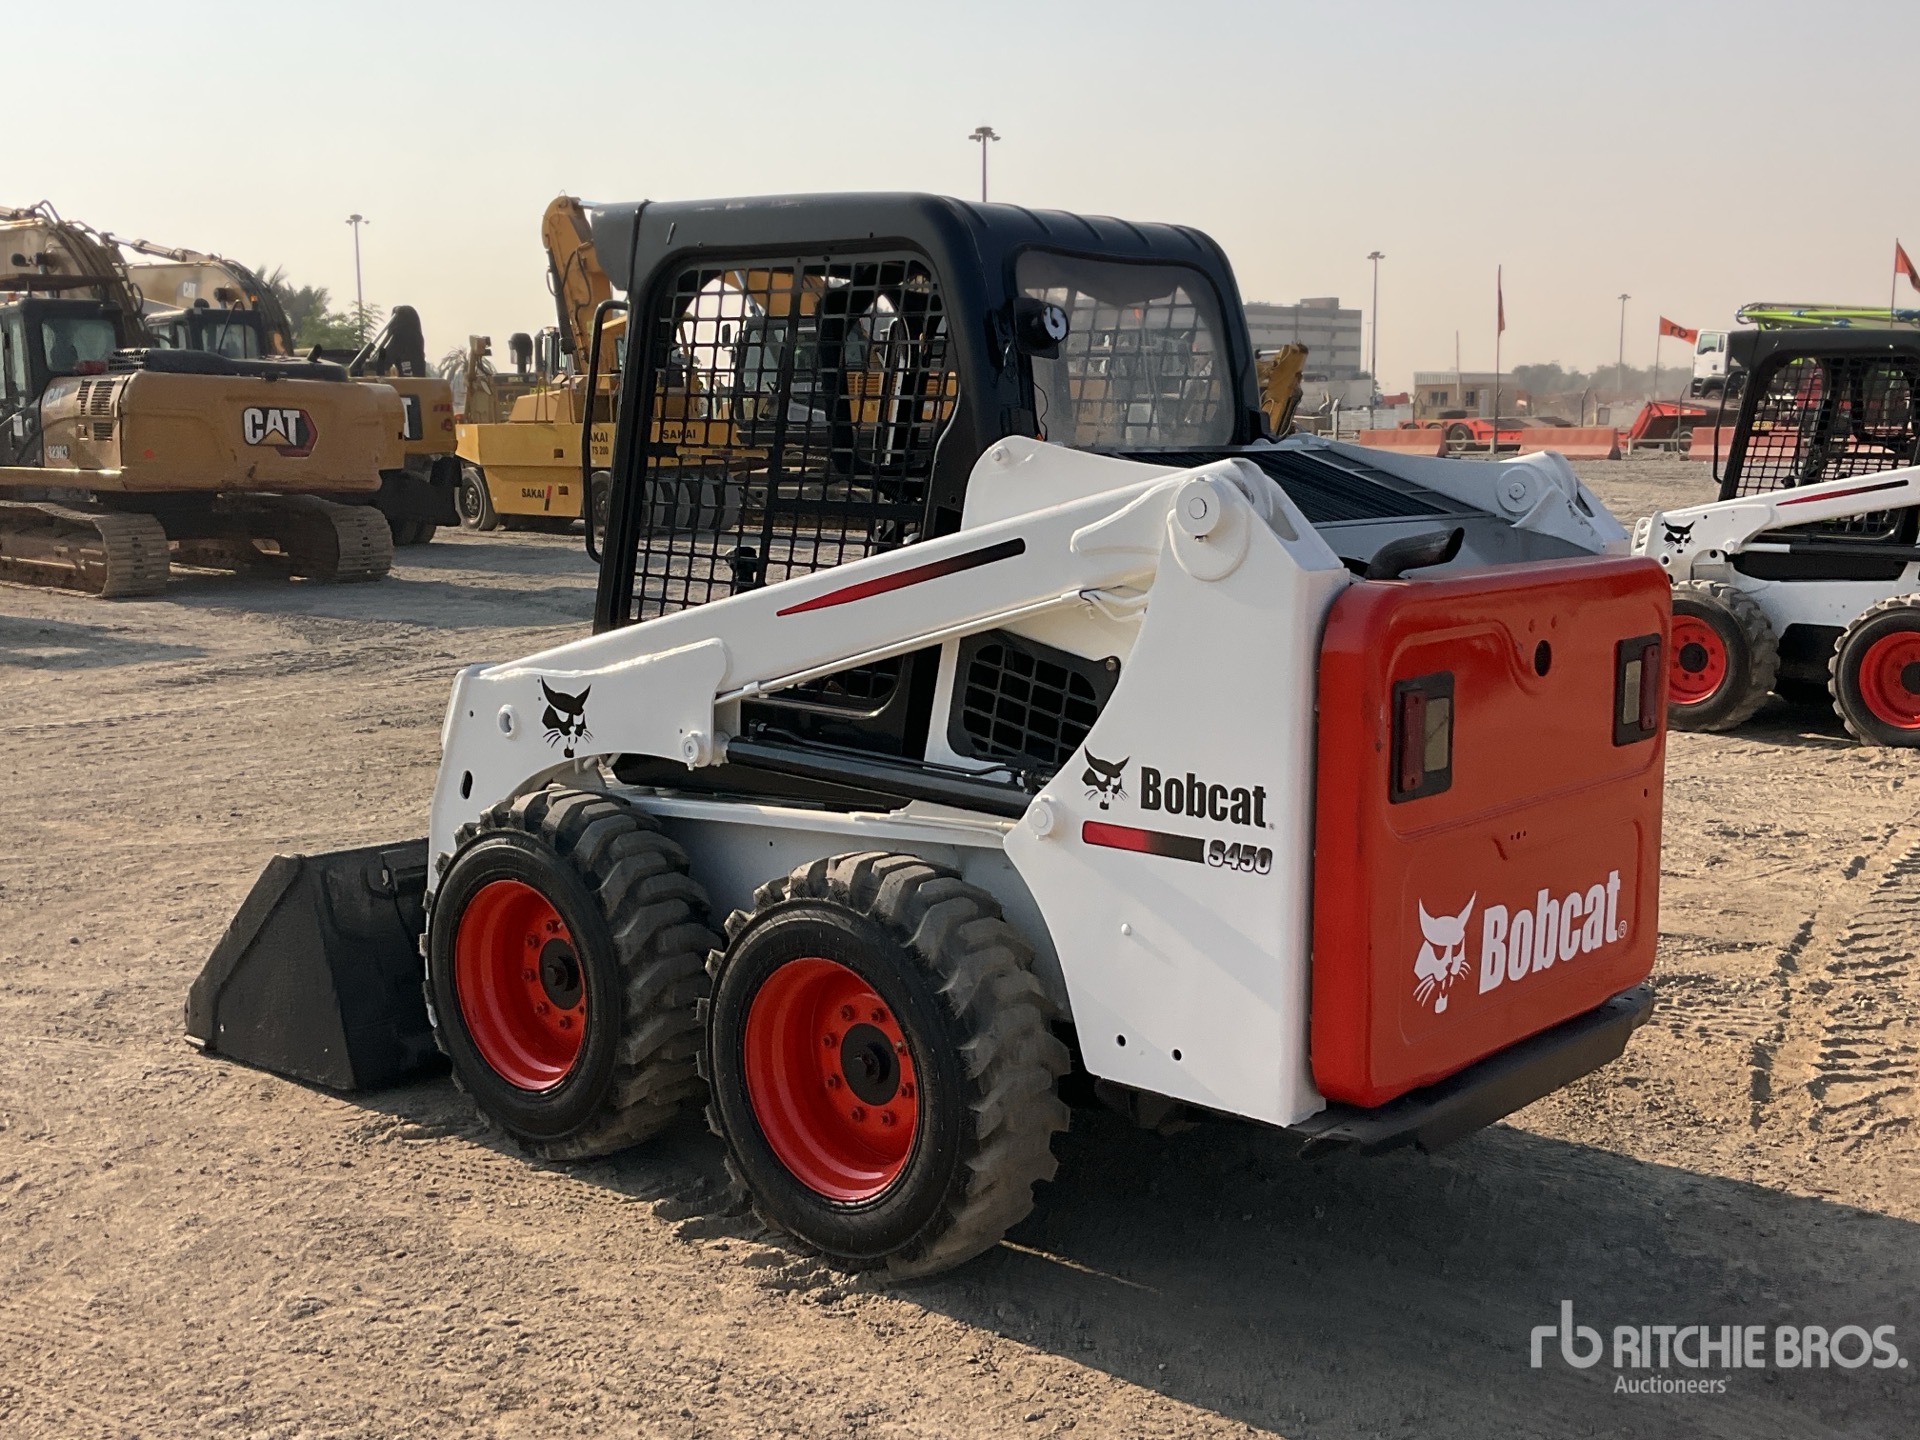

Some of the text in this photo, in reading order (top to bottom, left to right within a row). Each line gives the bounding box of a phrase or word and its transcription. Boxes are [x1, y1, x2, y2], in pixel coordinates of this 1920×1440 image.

[243, 407, 300, 446] CAT
[590, 431, 608, 442] AKAI
[592, 446, 599, 455] TS
[521, 488, 545, 499] SAKAI
[1207, 839, 1273, 875] S450
